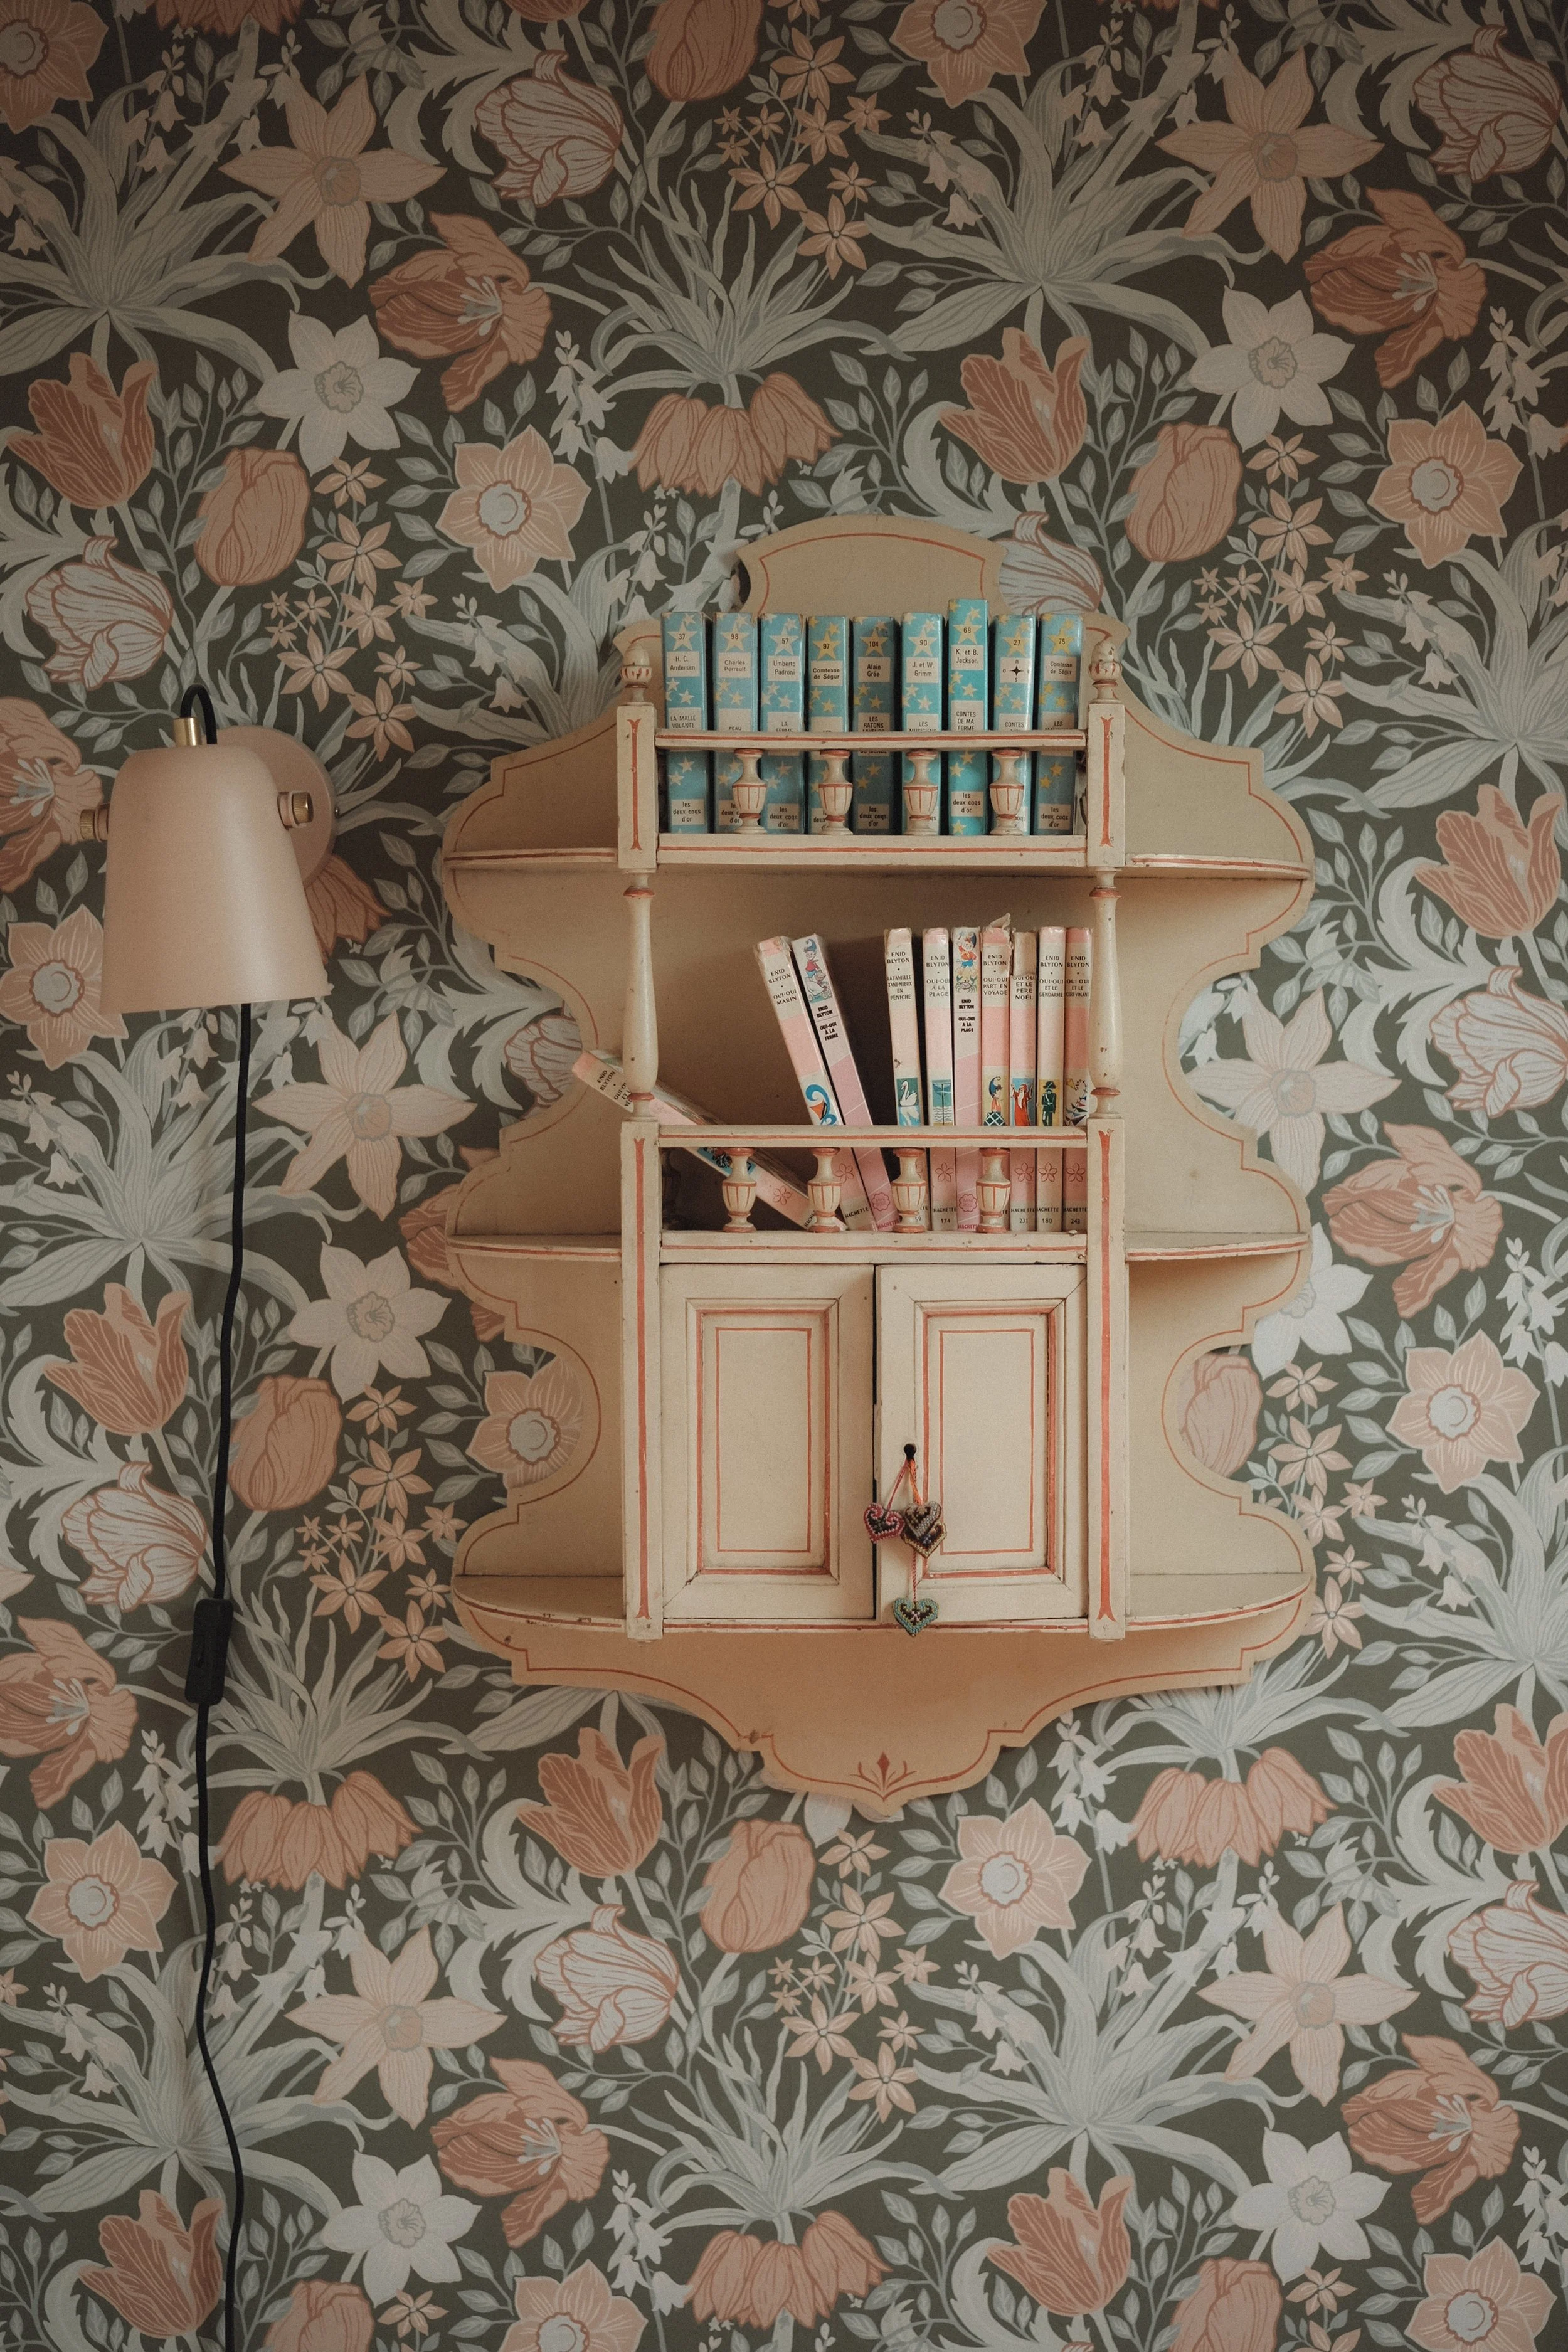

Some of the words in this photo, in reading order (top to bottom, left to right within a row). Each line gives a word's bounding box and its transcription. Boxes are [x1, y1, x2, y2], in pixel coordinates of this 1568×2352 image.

[770, 968, 785, 977] ENID
[768, 973, 791, 983] BLYTON
[773, 989, 796, 999] OUI-OUI
[776, 996, 797, 1005] MARIN
[817, 1010, 832, 1018] BLYTON
[820, 1022, 837, 1030] OUI-OUI
[597, 1070, 607, 1083] ENID
[600, 1071, 615, 1091] BLYTON
[845, 1207, 869, 1218] HACHETTE
